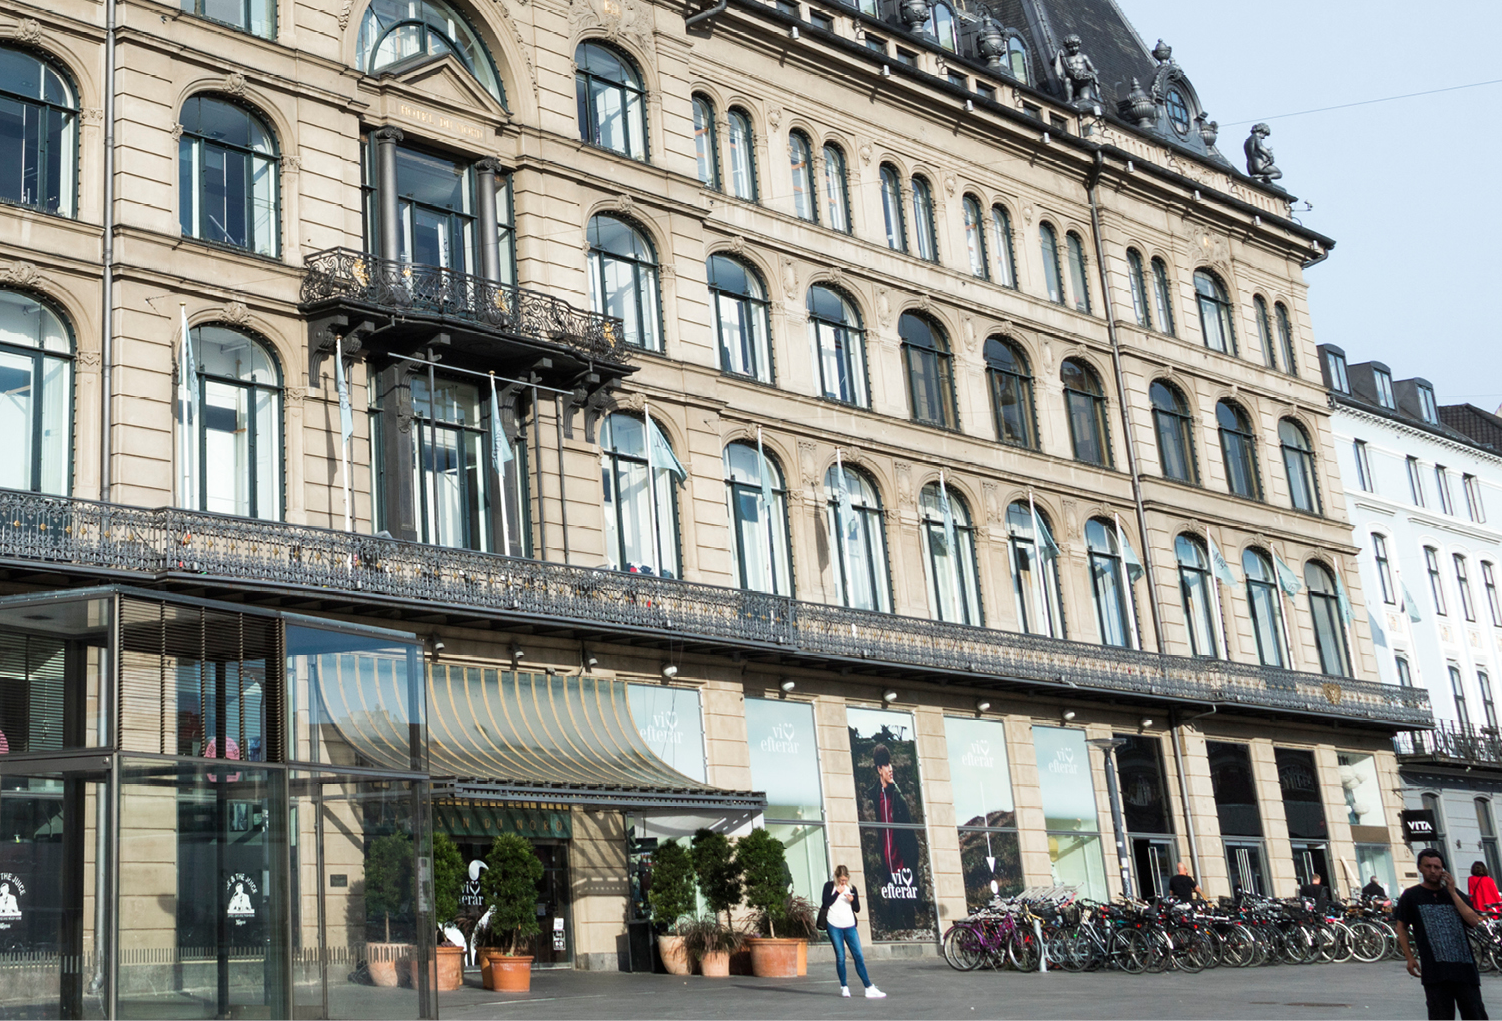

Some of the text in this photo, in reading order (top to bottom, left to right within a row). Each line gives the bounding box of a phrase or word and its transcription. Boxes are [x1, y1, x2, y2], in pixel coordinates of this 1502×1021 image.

[400, 104, 436, 126] HOTEL
[456, 121, 484, 140] NORD
[653, 711, 666, 728] vi
[771, 724, 784, 739] vi
[483, 817, 504, 832] DU
[515, 819, 564, 833] NORD
[1406, 820, 1433, 830] VITA
[0, 872, 12, 881] THE
[11, 875, 27, 896] JUICE
[890, 868, 903, 885] vi
